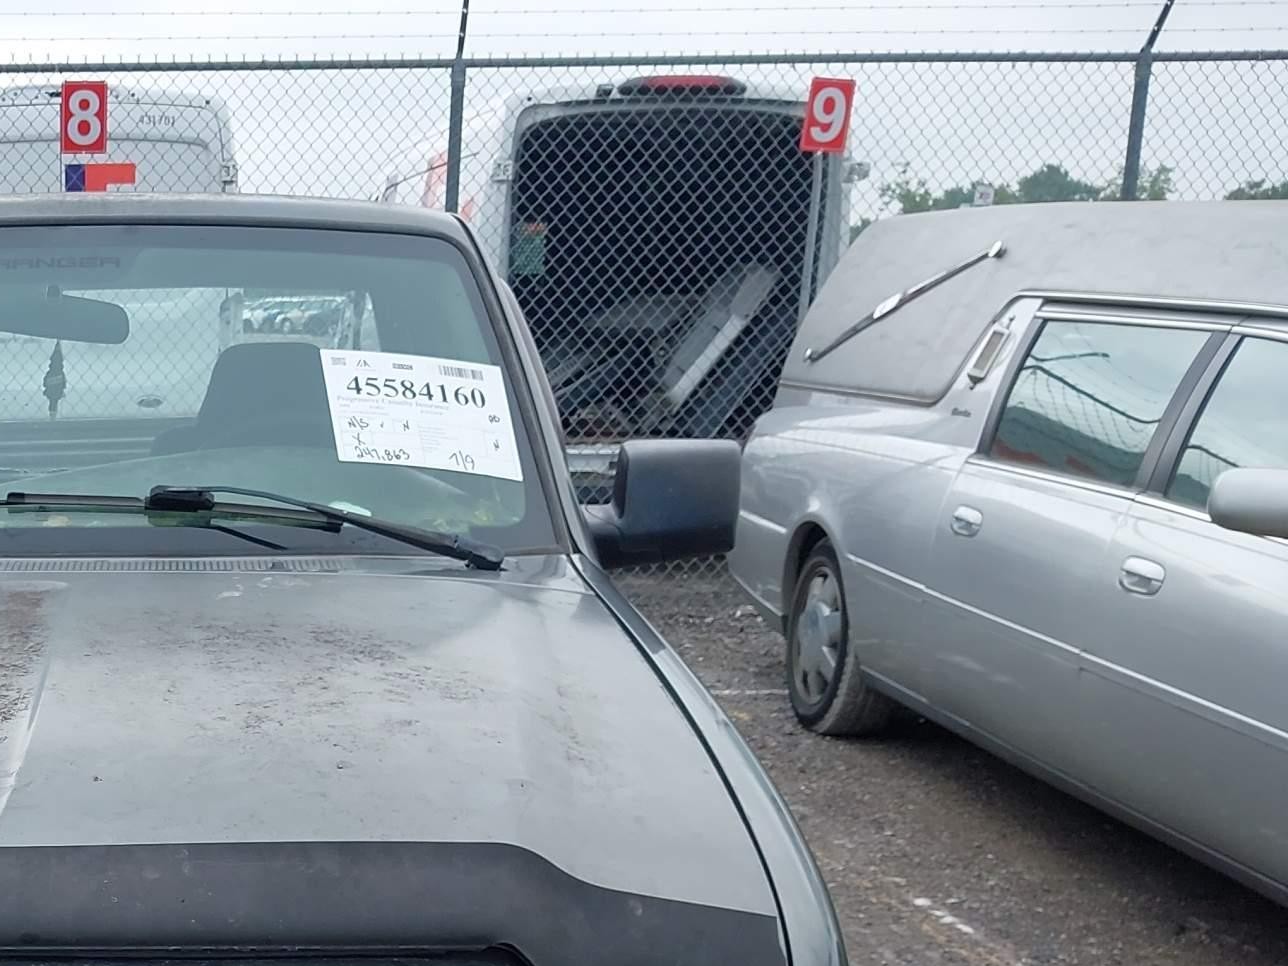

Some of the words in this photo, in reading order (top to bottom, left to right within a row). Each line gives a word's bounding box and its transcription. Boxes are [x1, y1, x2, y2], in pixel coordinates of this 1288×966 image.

[67, 90, 102, 146] 8
[810, 87, 846, 143] 9
[346, 375, 486, 409] 45584160
